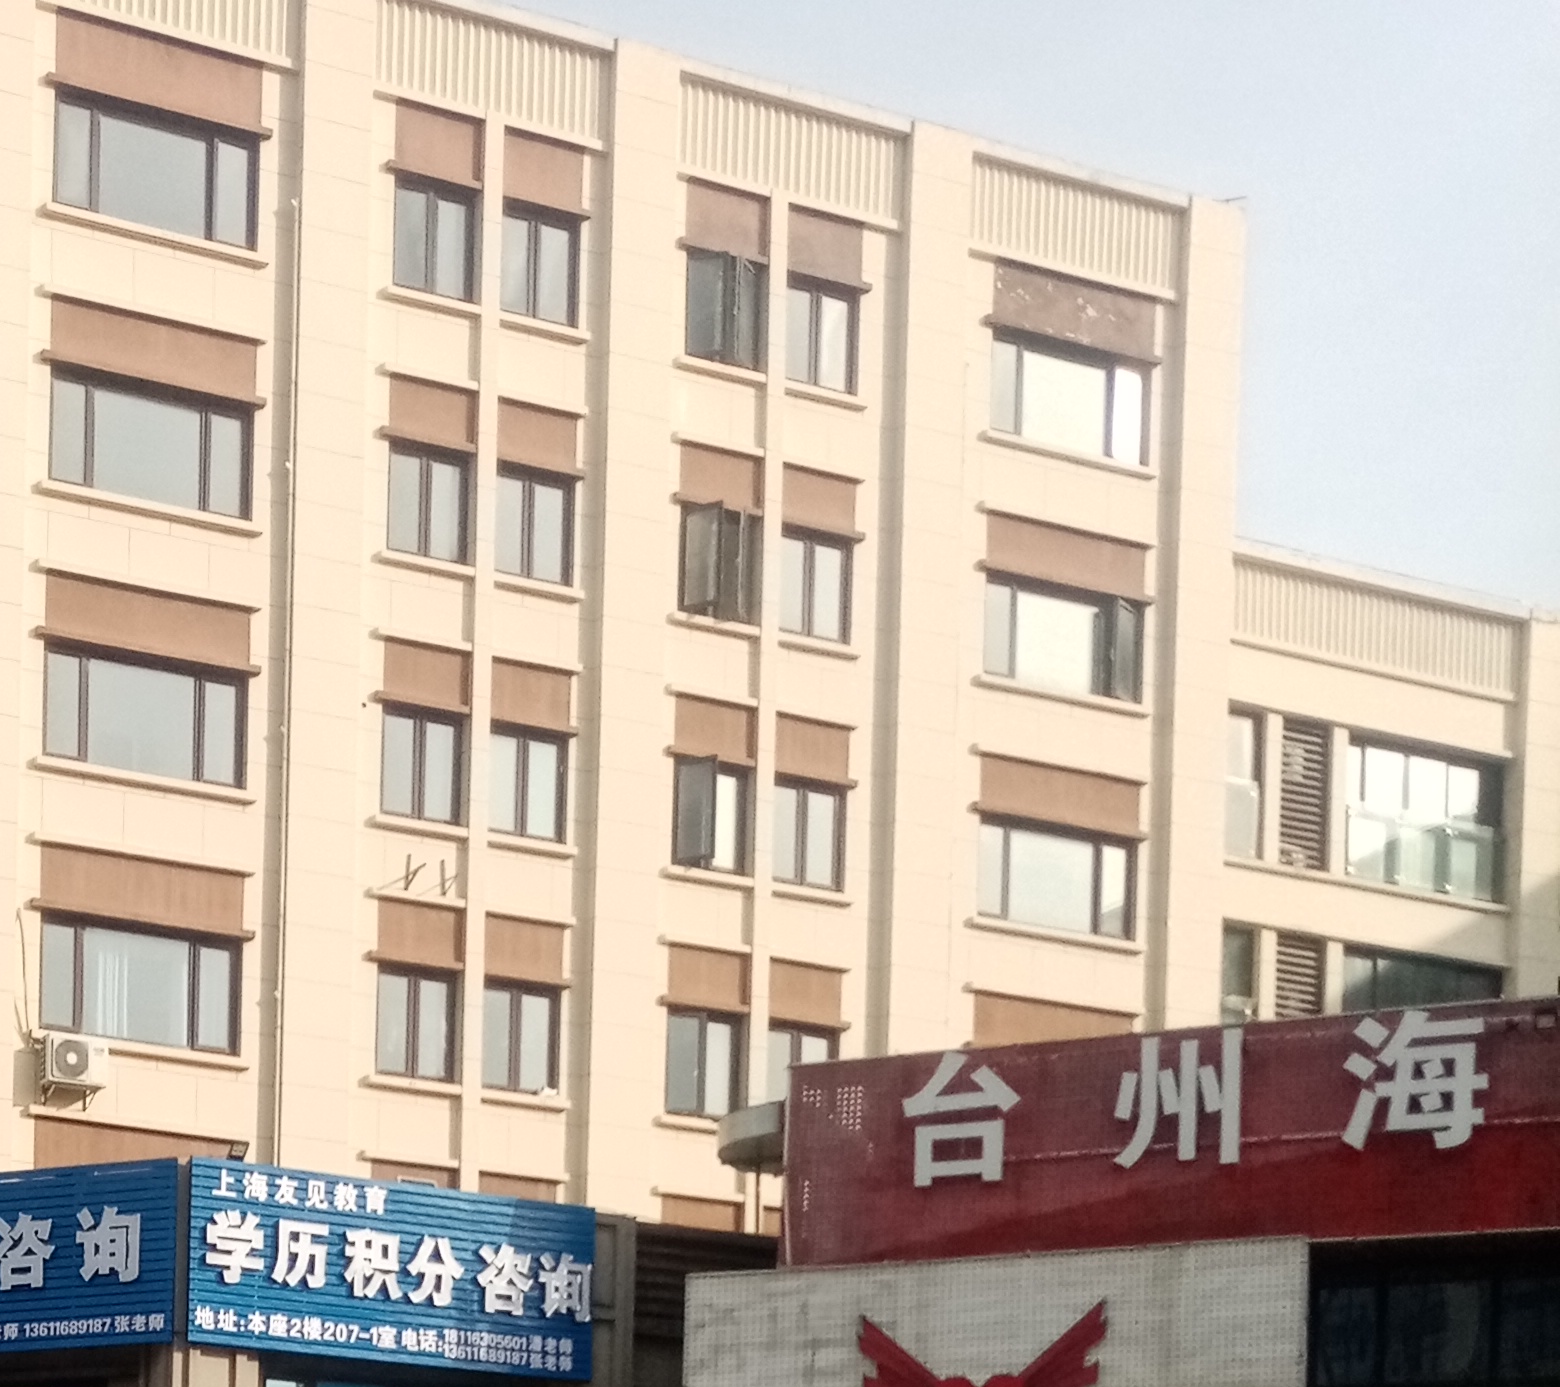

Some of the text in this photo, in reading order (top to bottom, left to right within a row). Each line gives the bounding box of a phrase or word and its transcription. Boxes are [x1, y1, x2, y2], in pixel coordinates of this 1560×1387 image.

[902, 1009, 1490, 1188] 台州海
[211, 1169, 388, 1216] 上海友见教育
[204, 1209, 593, 1323] 学历积分咨询
